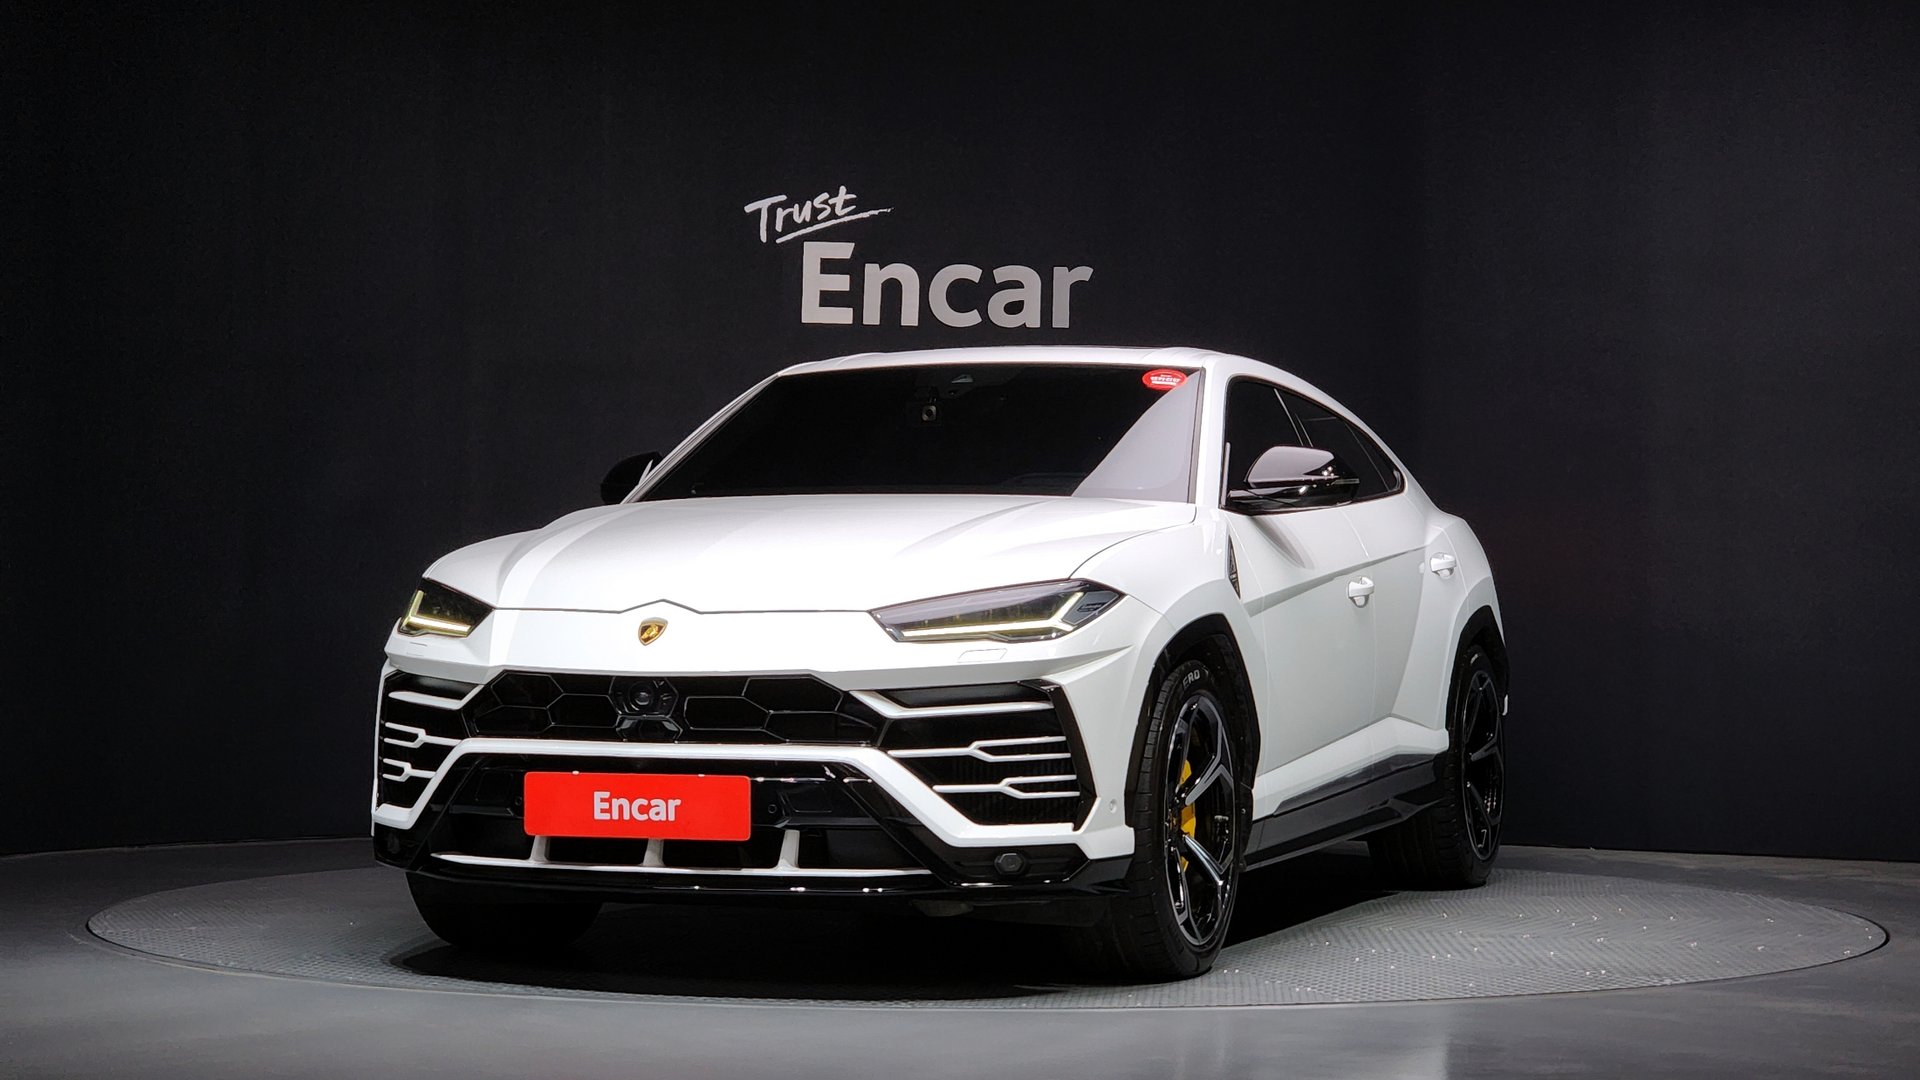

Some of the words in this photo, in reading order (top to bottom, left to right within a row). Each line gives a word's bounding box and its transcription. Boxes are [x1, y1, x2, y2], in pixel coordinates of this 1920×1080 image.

[744, 186, 858, 243] Trust
[801, 241, 1094, 328] Encar
[593, 791, 682, 821] Encar
